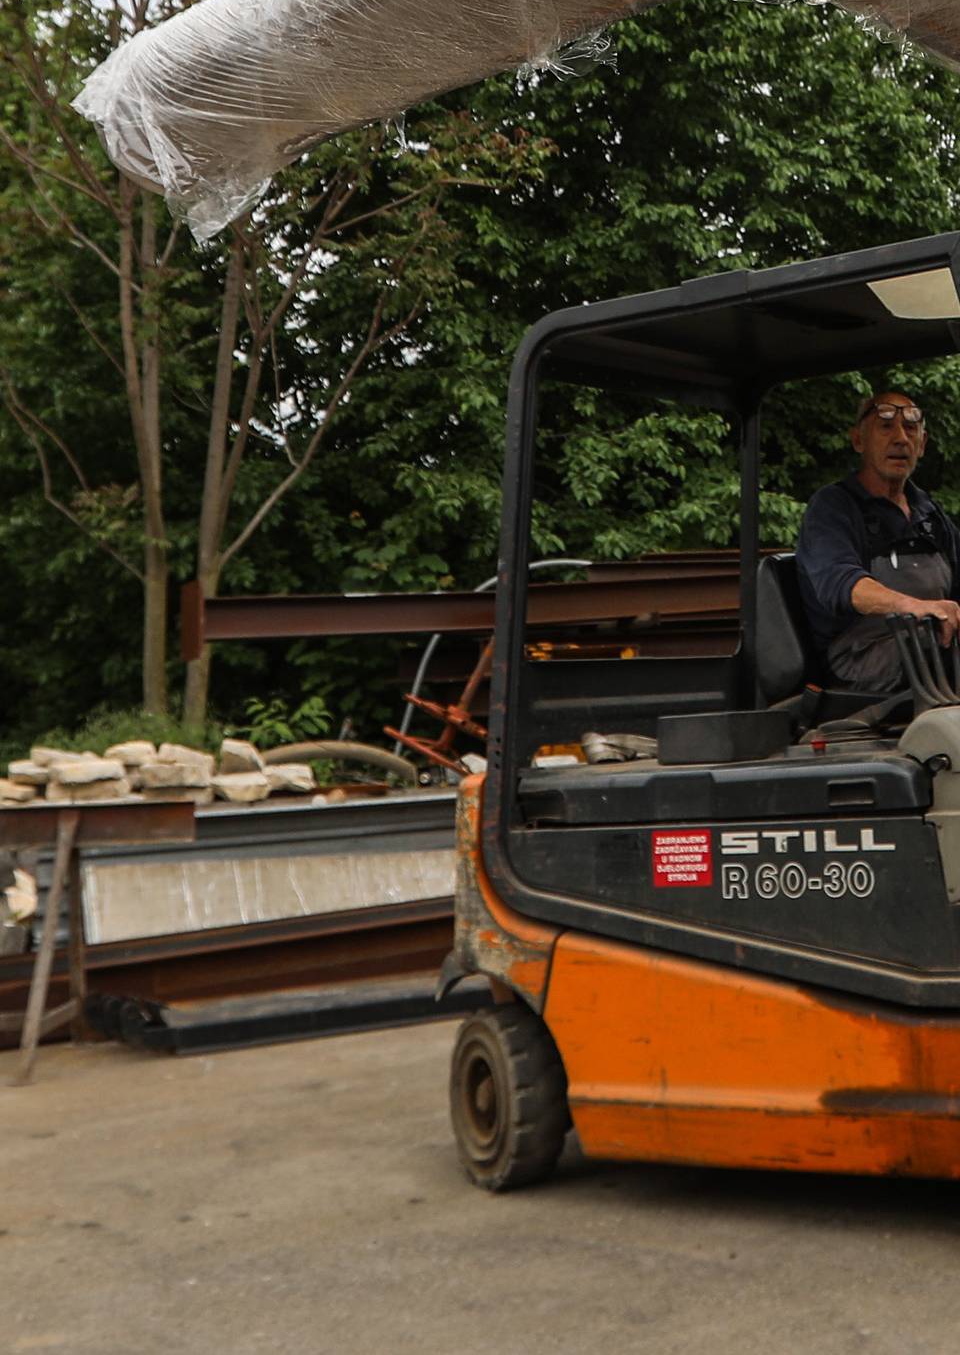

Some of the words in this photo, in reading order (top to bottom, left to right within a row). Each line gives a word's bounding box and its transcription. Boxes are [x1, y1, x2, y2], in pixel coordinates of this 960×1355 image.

[721, 829, 895, 854] STILL
[667, 873, 697, 882] STROJA
[721, 863, 748, 899] R
[755, 861, 875, 899] 60-30
